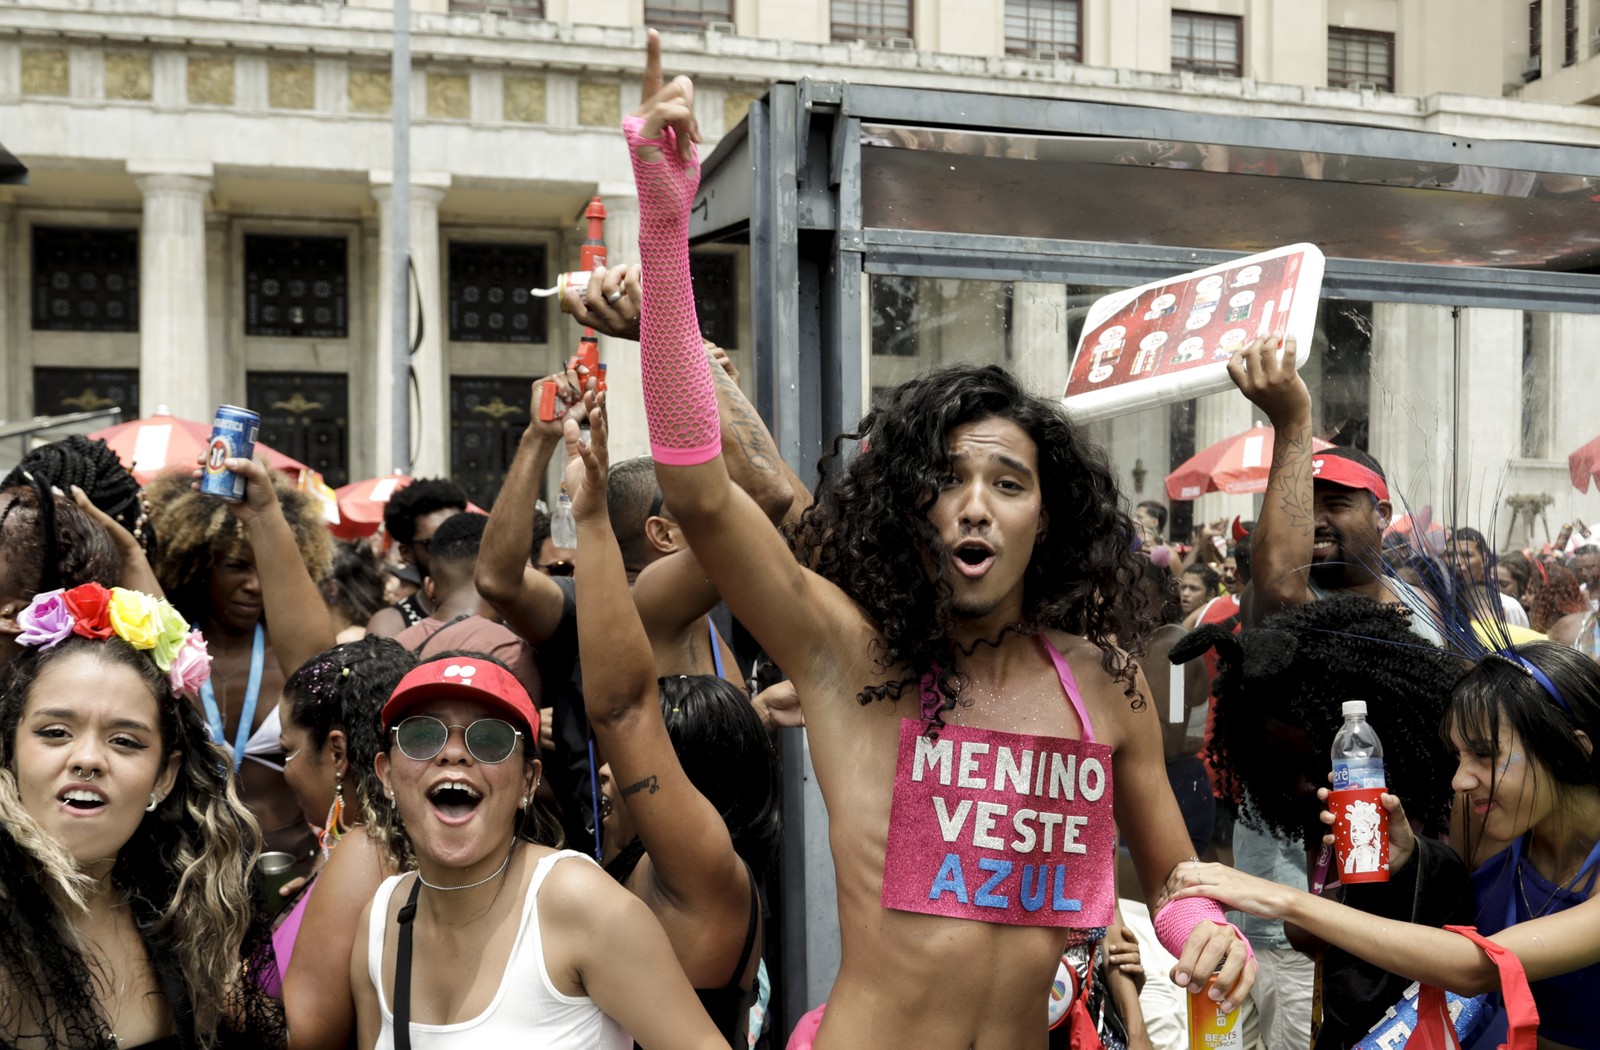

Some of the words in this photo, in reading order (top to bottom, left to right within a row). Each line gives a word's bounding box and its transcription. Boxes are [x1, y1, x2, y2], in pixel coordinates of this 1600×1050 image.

[911, 735, 1106, 802] MENINO
[932, 796, 1088, 854] VESTE
[928, 853, 1082, 912] AZUL
[1205, 1031, 1237, 1042] BEATS
